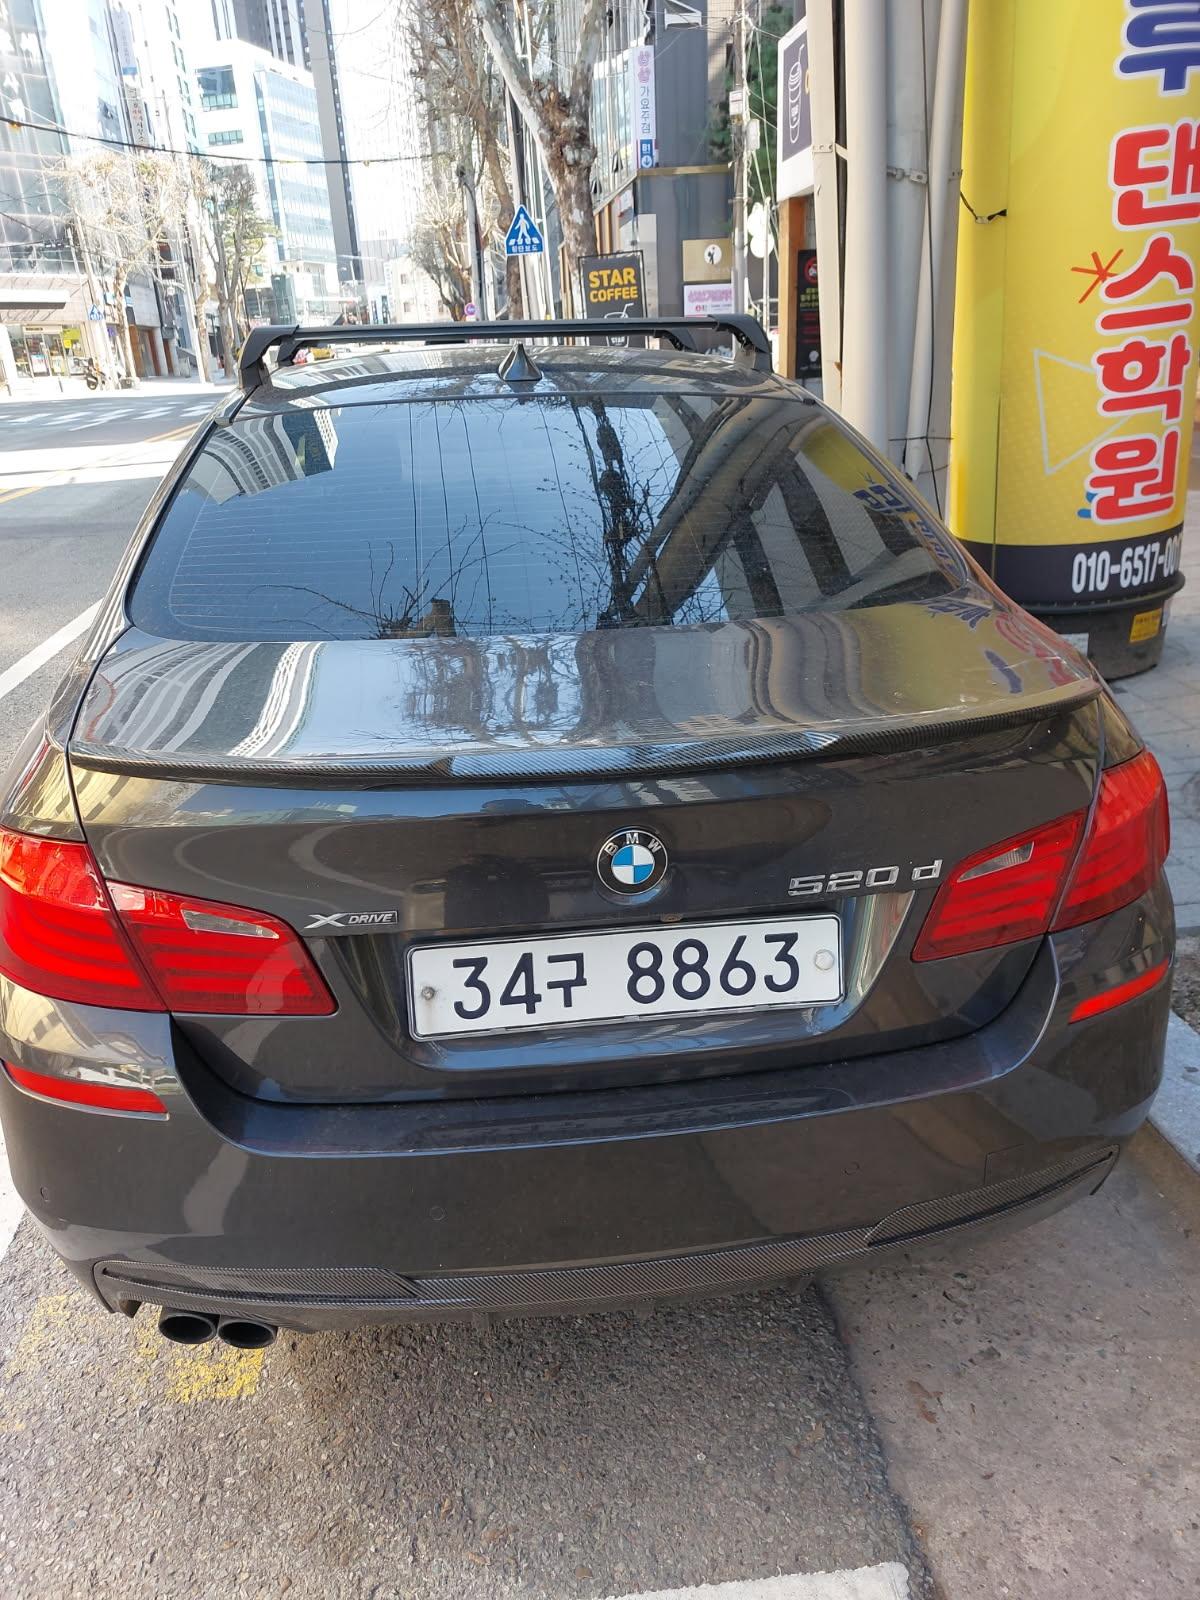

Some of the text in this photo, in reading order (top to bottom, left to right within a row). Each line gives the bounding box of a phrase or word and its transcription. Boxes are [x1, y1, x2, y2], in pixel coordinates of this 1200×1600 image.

[641, 143, 651, 153] B1
[588, 267, 636, 289] STAR
[589, 286, 639, 303] COFFEE
[1088, 122, 1200, 521] 댄스학원
[603, 832, 662, 857] BMW
[787, 859, 943, 897] 520 d
[452, 932, 800, 1020] 34구 8863
